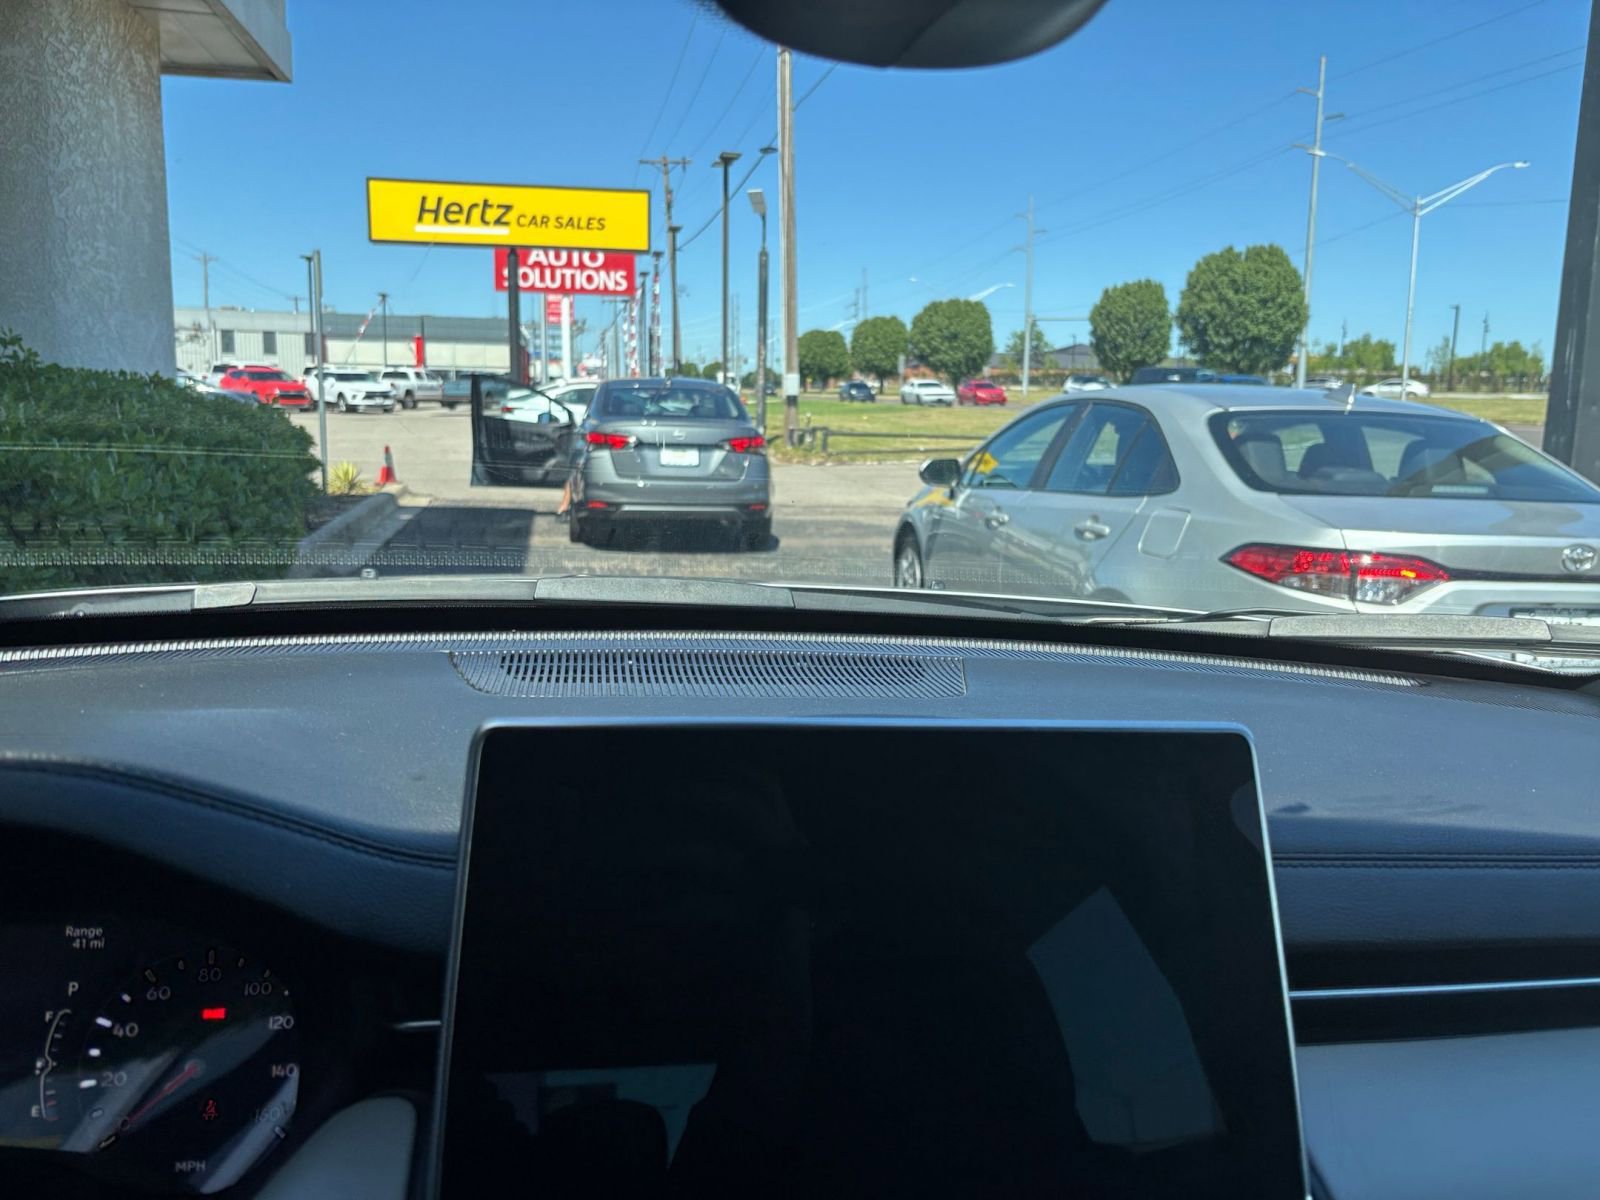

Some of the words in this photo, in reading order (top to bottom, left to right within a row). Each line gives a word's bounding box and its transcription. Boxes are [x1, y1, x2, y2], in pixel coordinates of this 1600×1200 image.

[417, 196, 514, 227] Hertz
[516, 213, 550, 229] CAR
[554, 216, 606, 232] SALES
[527, 249, 605, 268] AUTO
[65, 926, 104, 939] Range
[72, 938, 87, 949] 41
[90, 938, 105, 949] mi
[198, 967, 222, 982] 80
[68, 981, 80, 997] P
[146, 985, 172, 1001] 60
[244, 981, 272, 996] 100
[44, 1010, 54, 1024] F
[268, 1015, 295, 1030] 120
[112, 1022, 139, 1039] 40
[271, 1063, 297, 1079] 140
[101, 1071, 128, 1088] 20
[31, 1104, 41, 1118] E
[175, 1160, 207, 1173] MPH
